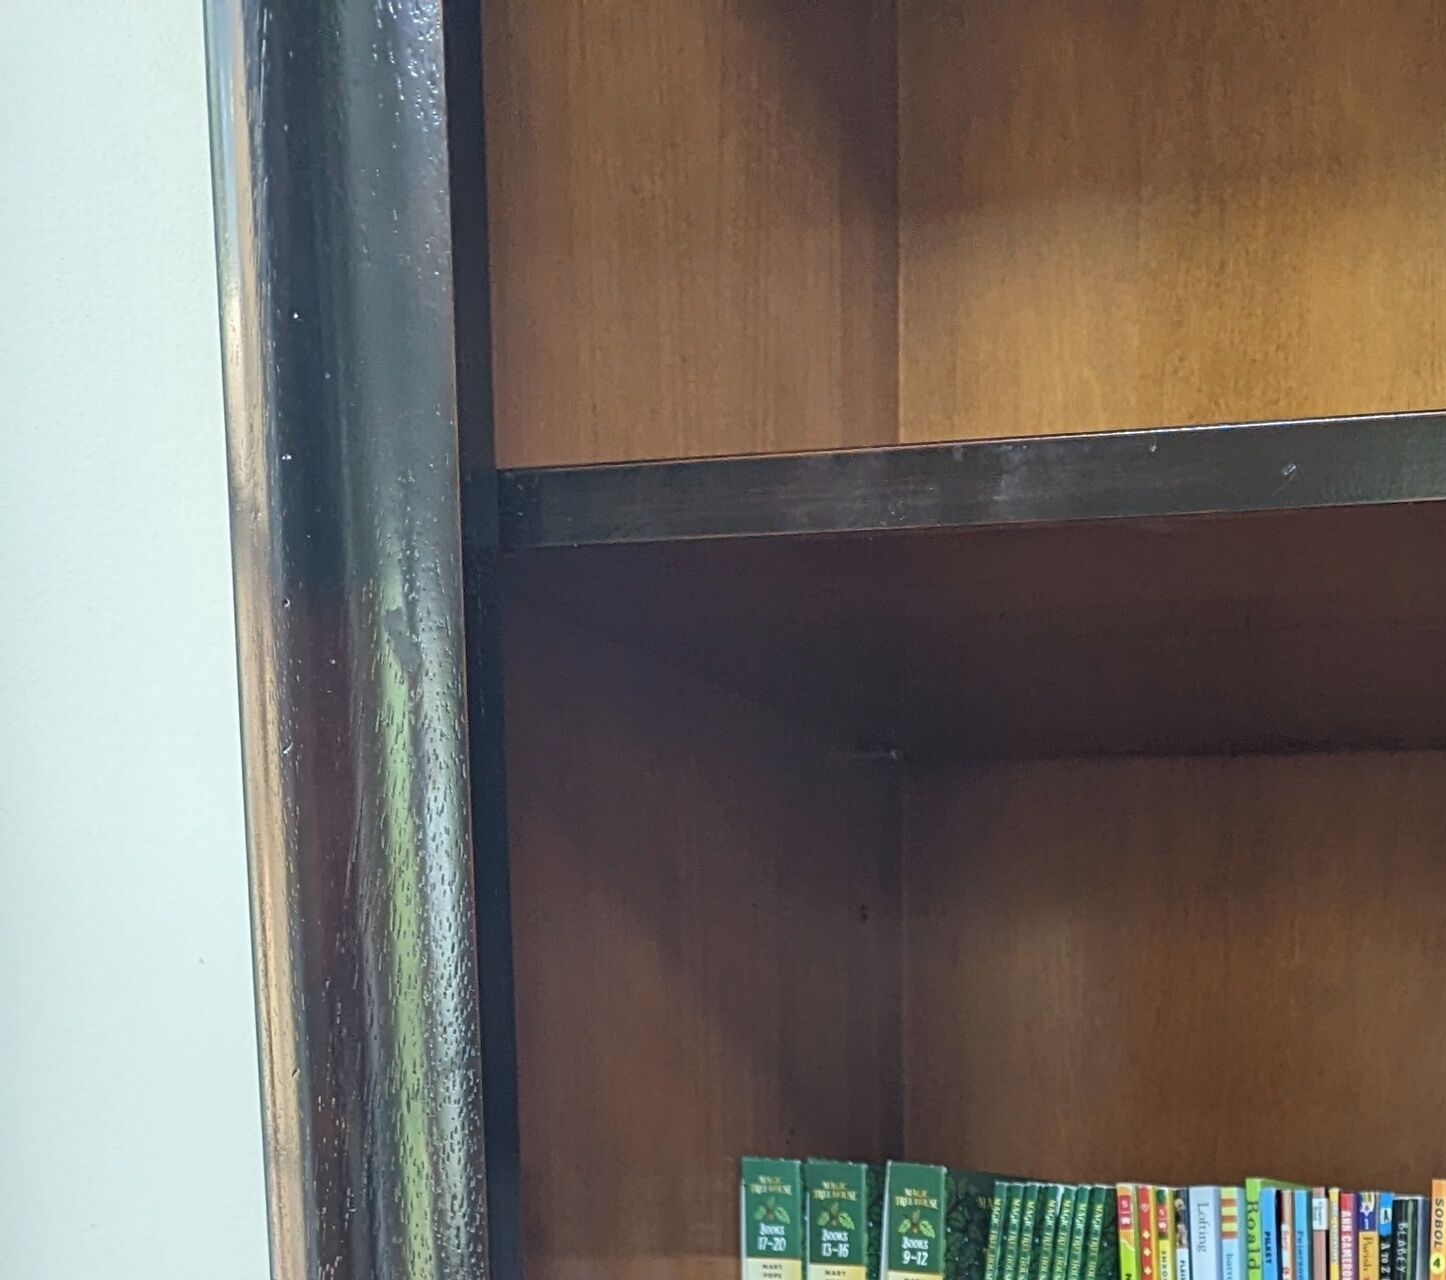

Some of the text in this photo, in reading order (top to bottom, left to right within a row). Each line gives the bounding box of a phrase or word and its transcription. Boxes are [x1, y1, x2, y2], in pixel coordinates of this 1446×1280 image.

[1197, 1202, 1211, 1252] Lofting
[1246, 1200, 1261, 1270] Roald
[1434, 1198, 1445, 1250] SOBOL
